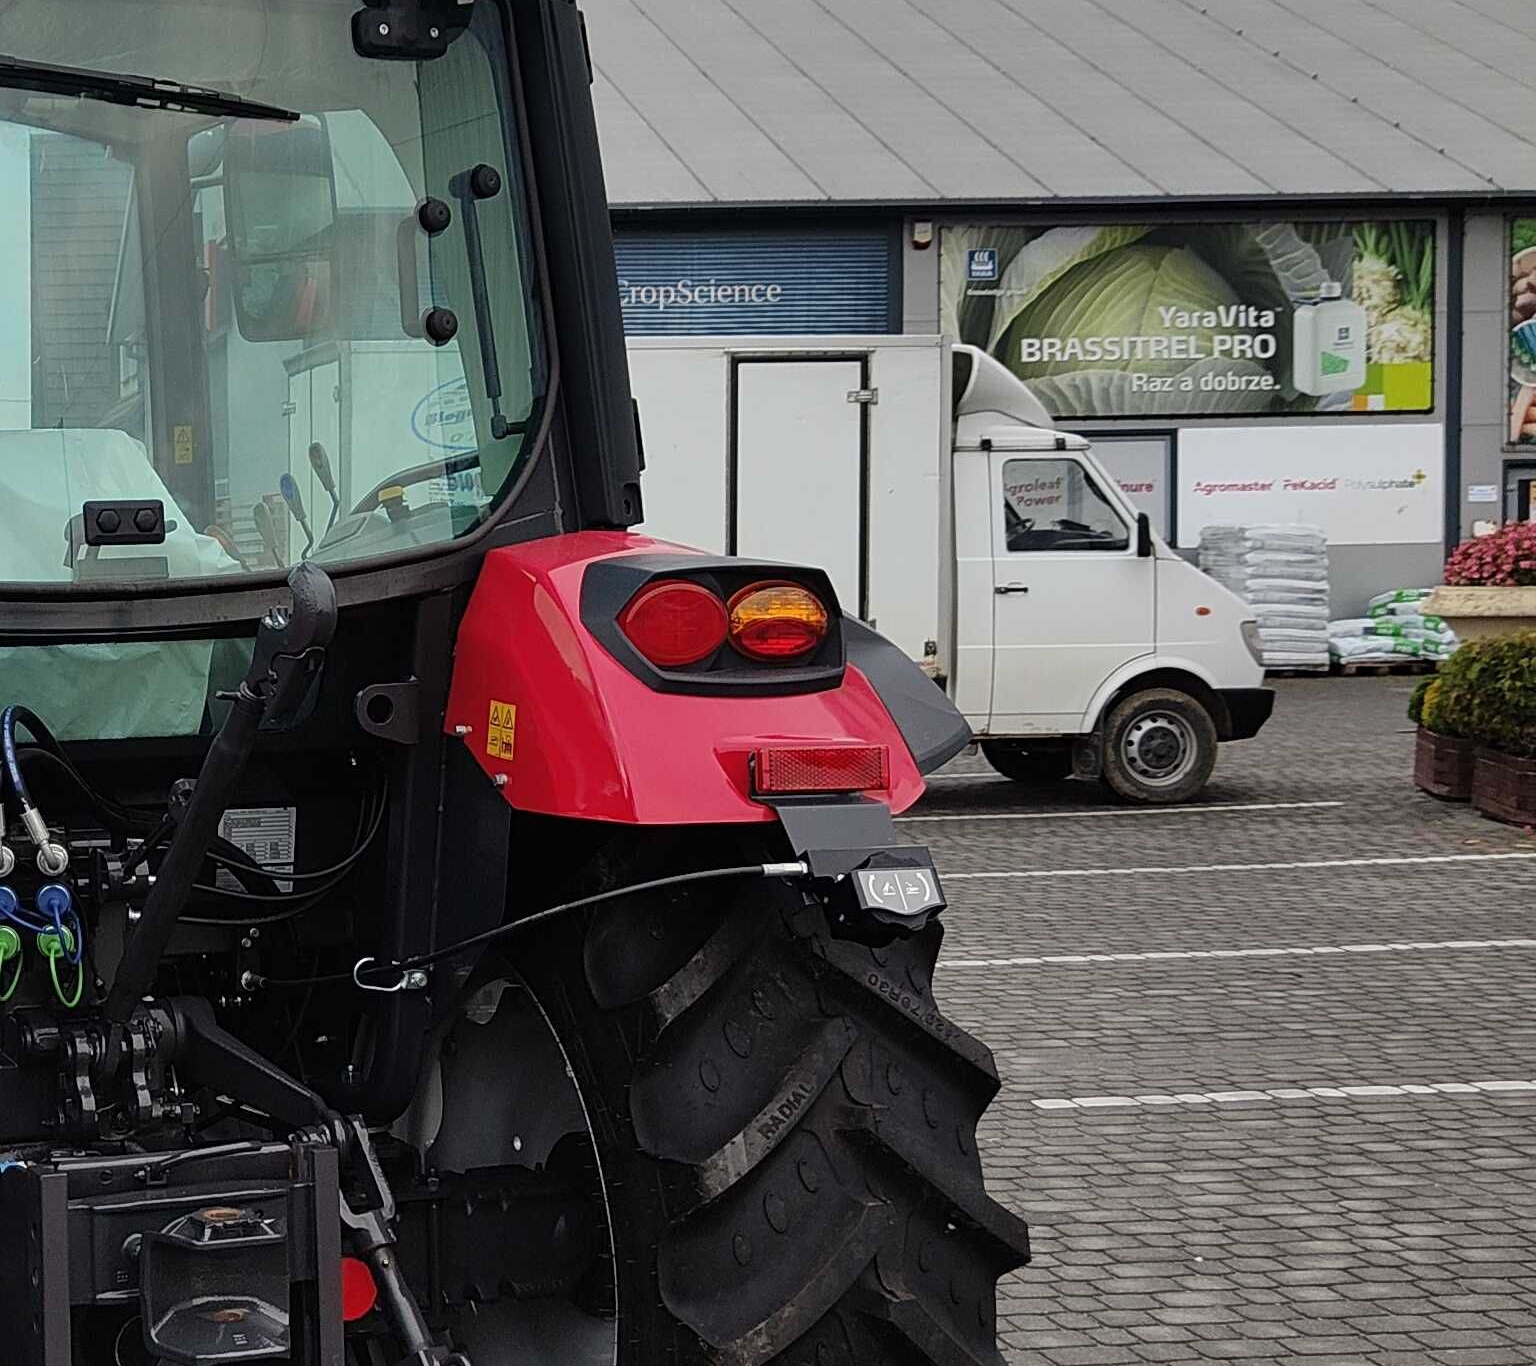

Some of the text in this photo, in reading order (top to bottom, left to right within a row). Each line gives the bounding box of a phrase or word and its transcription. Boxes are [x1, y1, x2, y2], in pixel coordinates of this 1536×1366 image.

[1158, 304, 1276, 329] YaraVita
[1020, 333, 1277, 363] BRASSITREL PRO
[1131, 370, 1281, 392] Raz a dobrze.
[1193, 480, 1273, 495] Agromaster
[1016, 494, 1063, 507] Power
[757, 1082, 816, 1141] RADIAL
